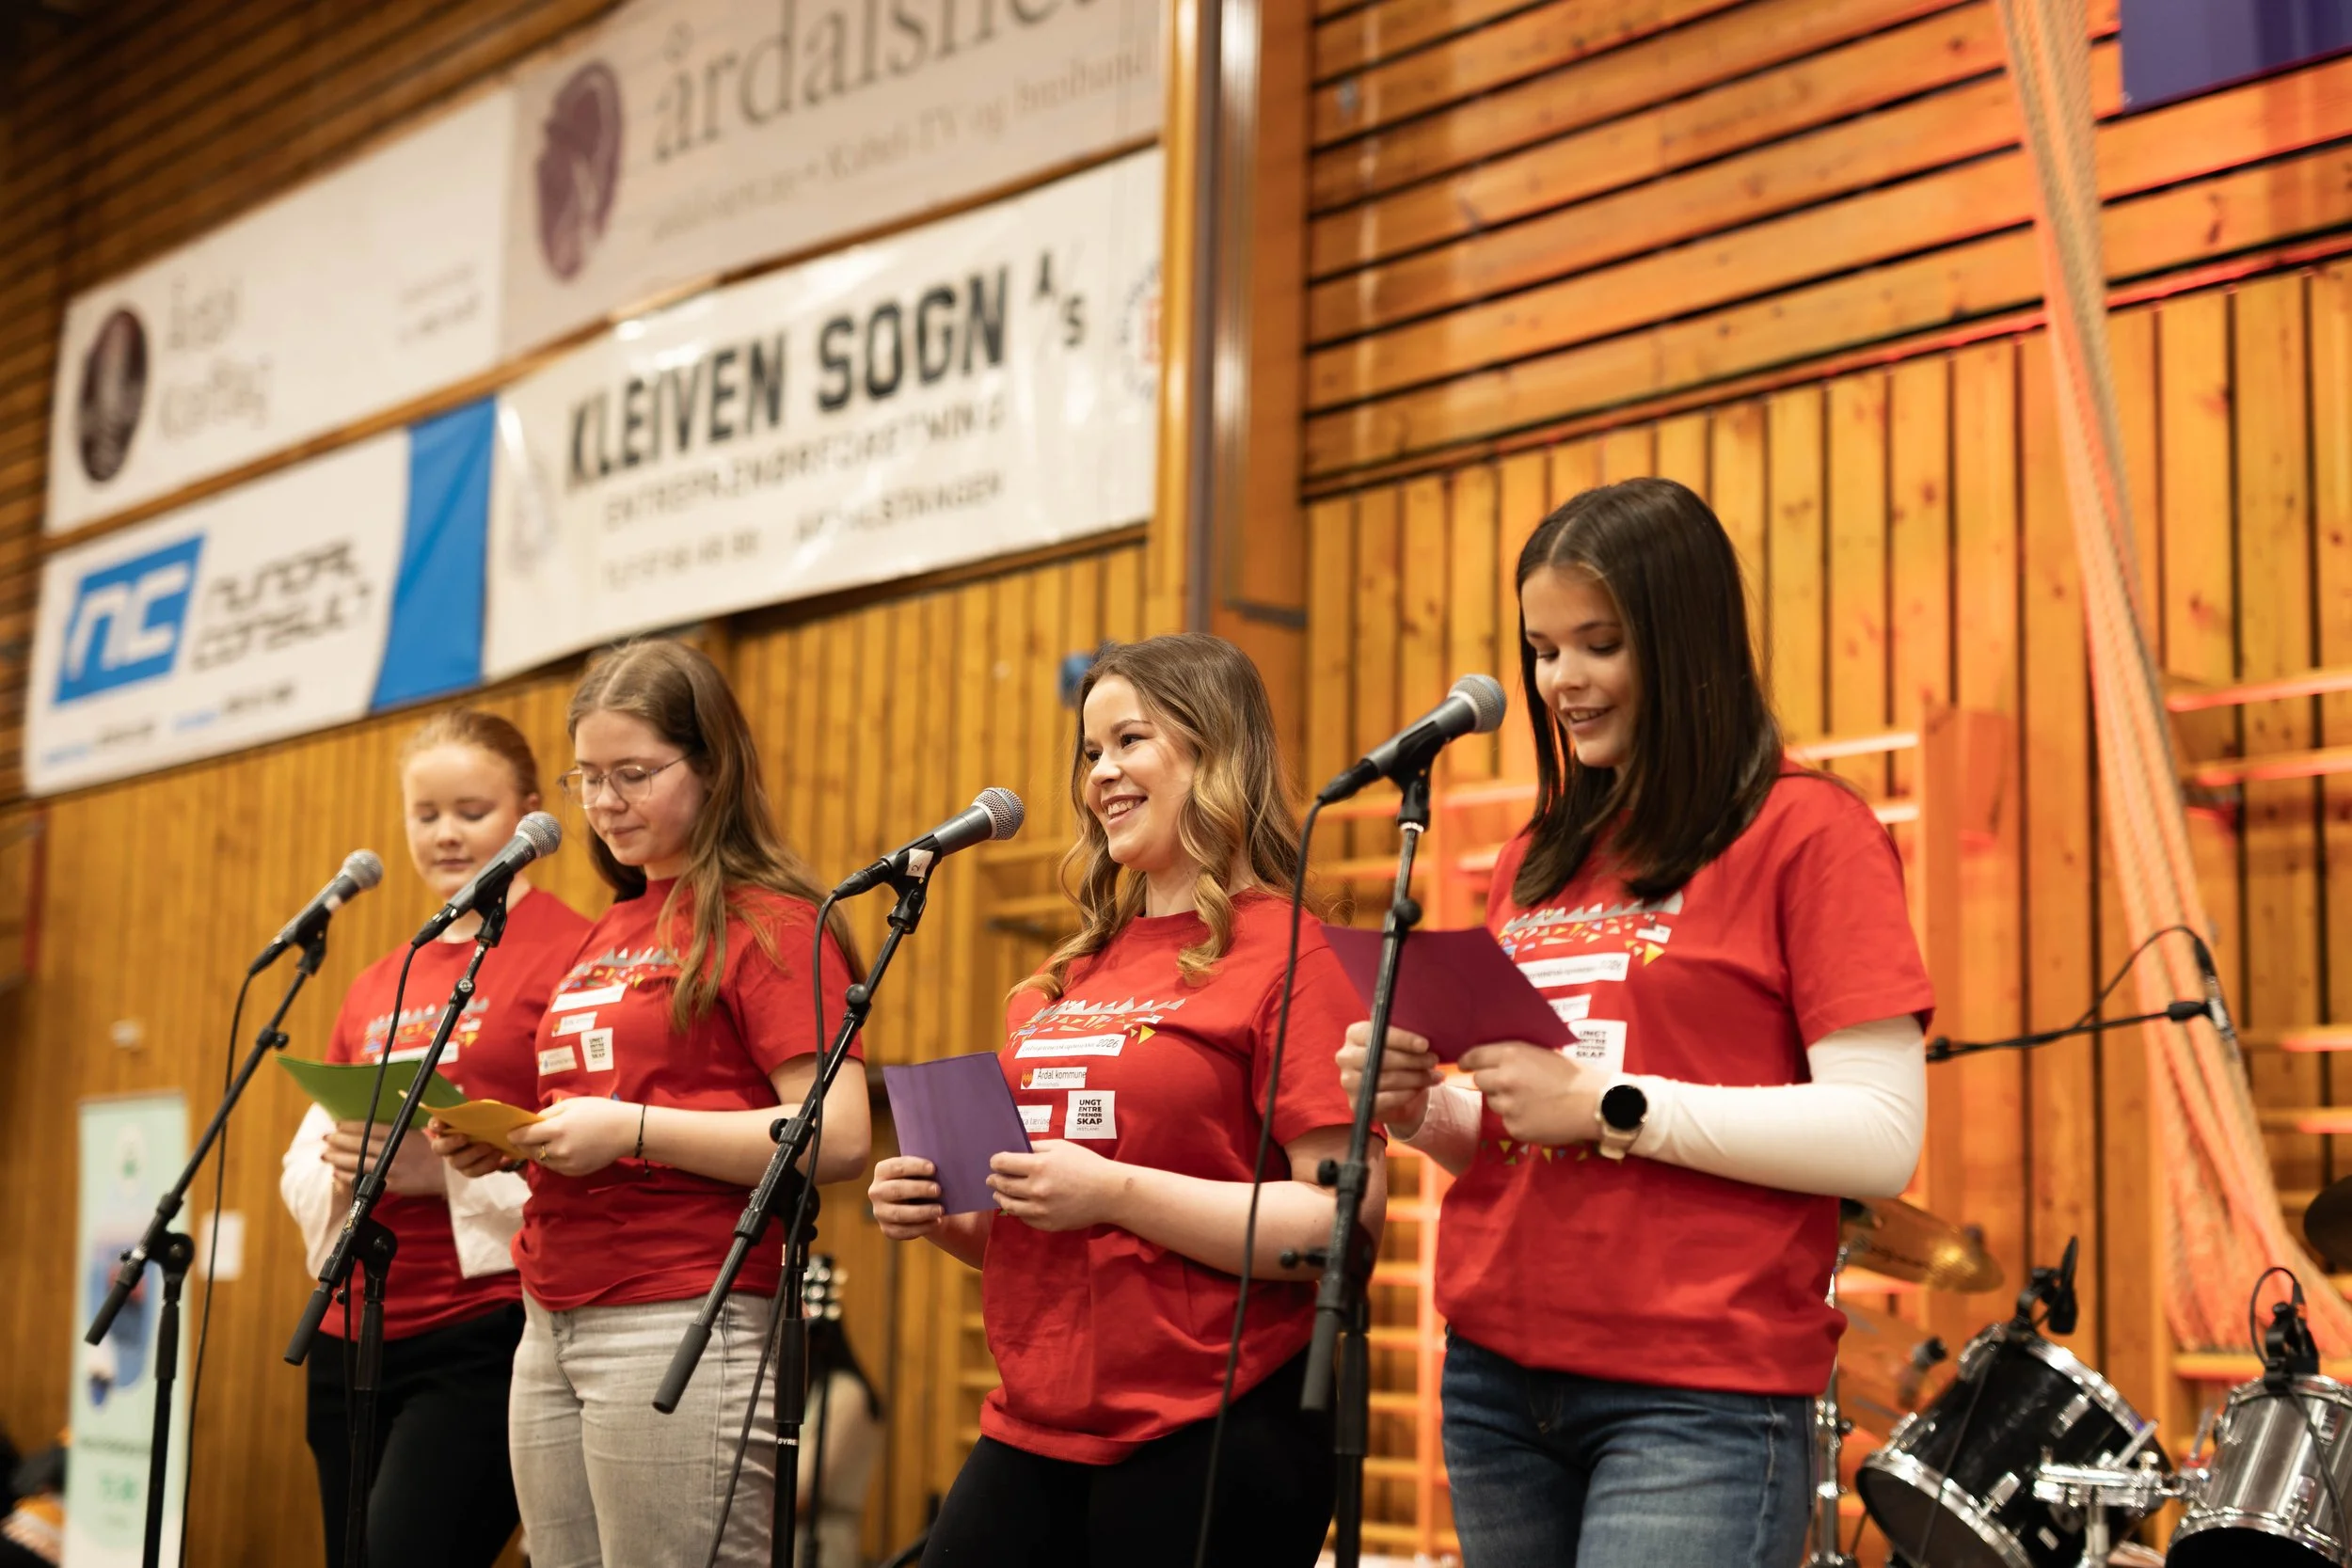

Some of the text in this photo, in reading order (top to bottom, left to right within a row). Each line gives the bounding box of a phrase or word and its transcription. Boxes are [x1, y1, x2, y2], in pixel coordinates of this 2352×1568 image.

[569, 335, 787, 489] KLEIVEN
[817, 266, 1009, 414] SOGN
[1096, 1038, 1119, 1048] 2026
[1037, 1068, 1087, 1079] Årdal kommune
